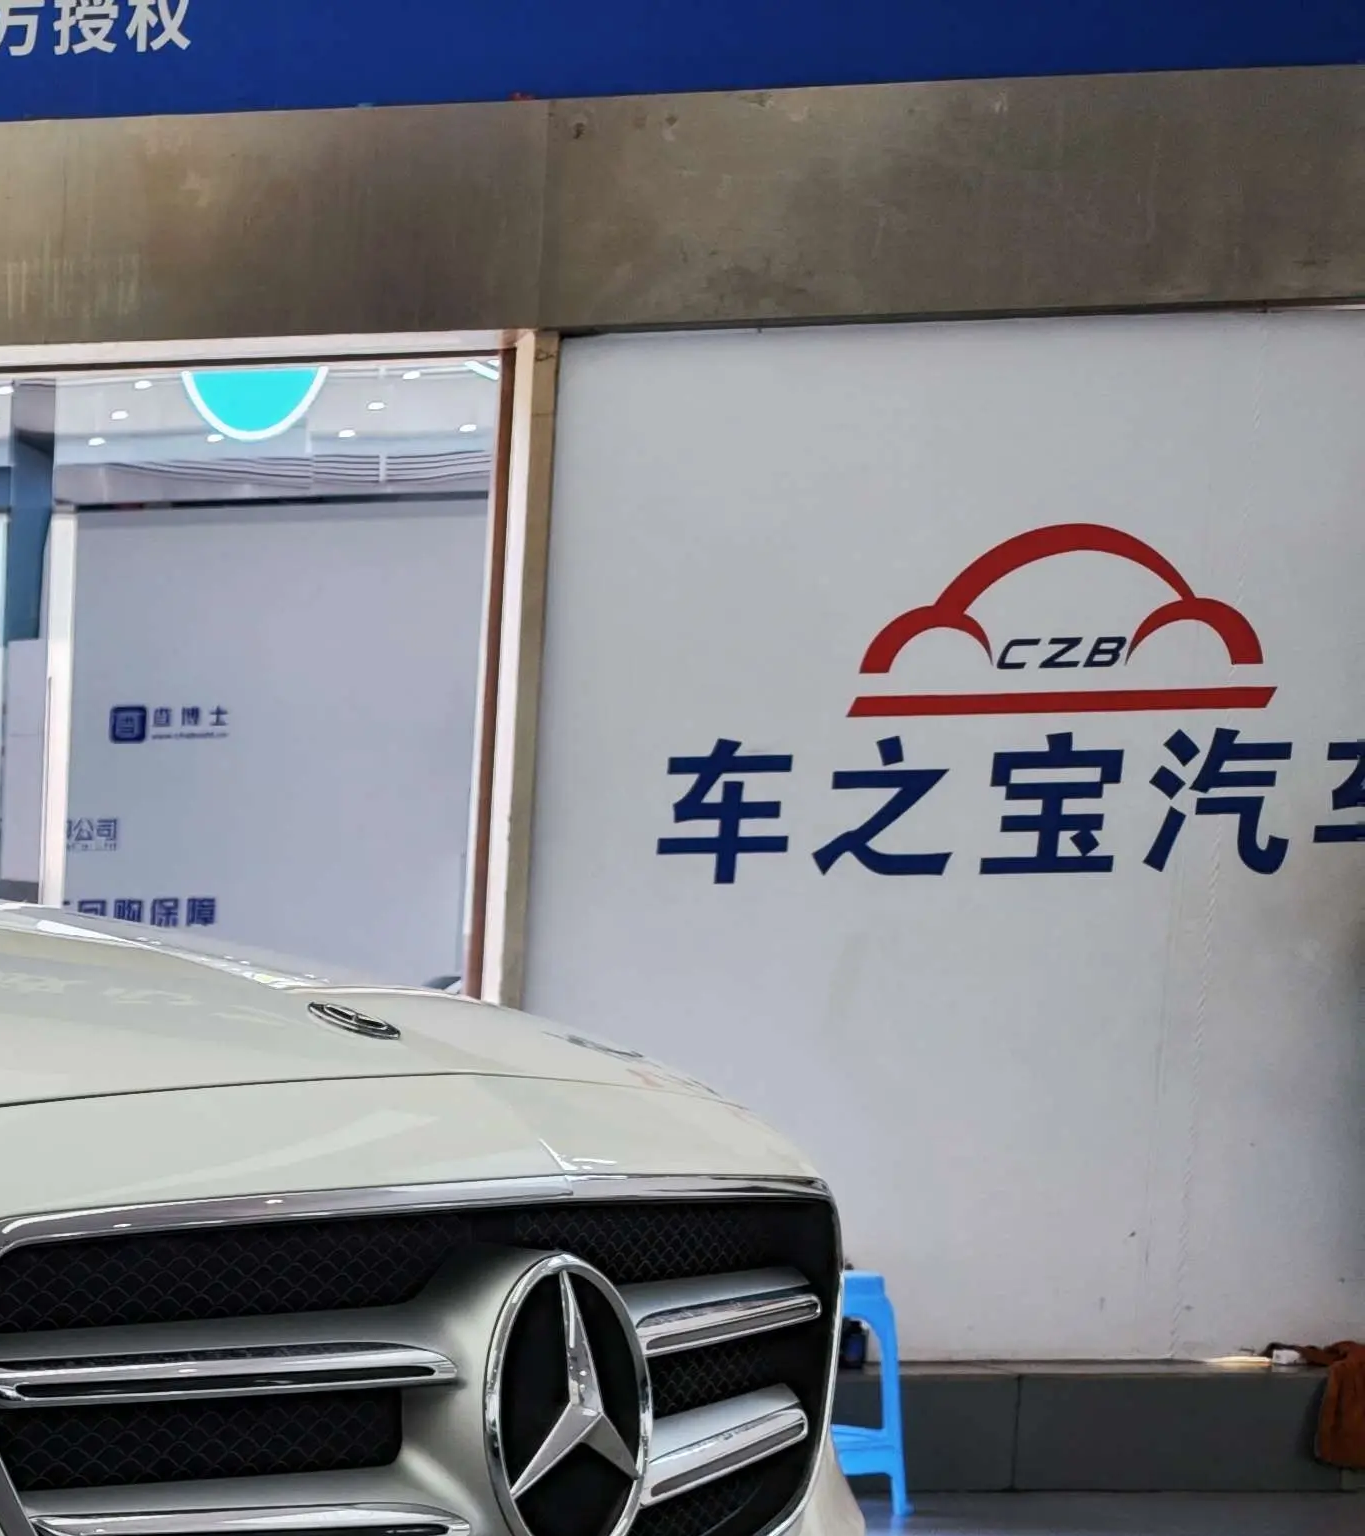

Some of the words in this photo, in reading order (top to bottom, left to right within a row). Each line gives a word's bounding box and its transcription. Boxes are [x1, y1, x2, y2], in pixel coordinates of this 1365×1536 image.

[996, 635, 1127, 671] CZB
[63, 897, 216, 928] 回购保障
